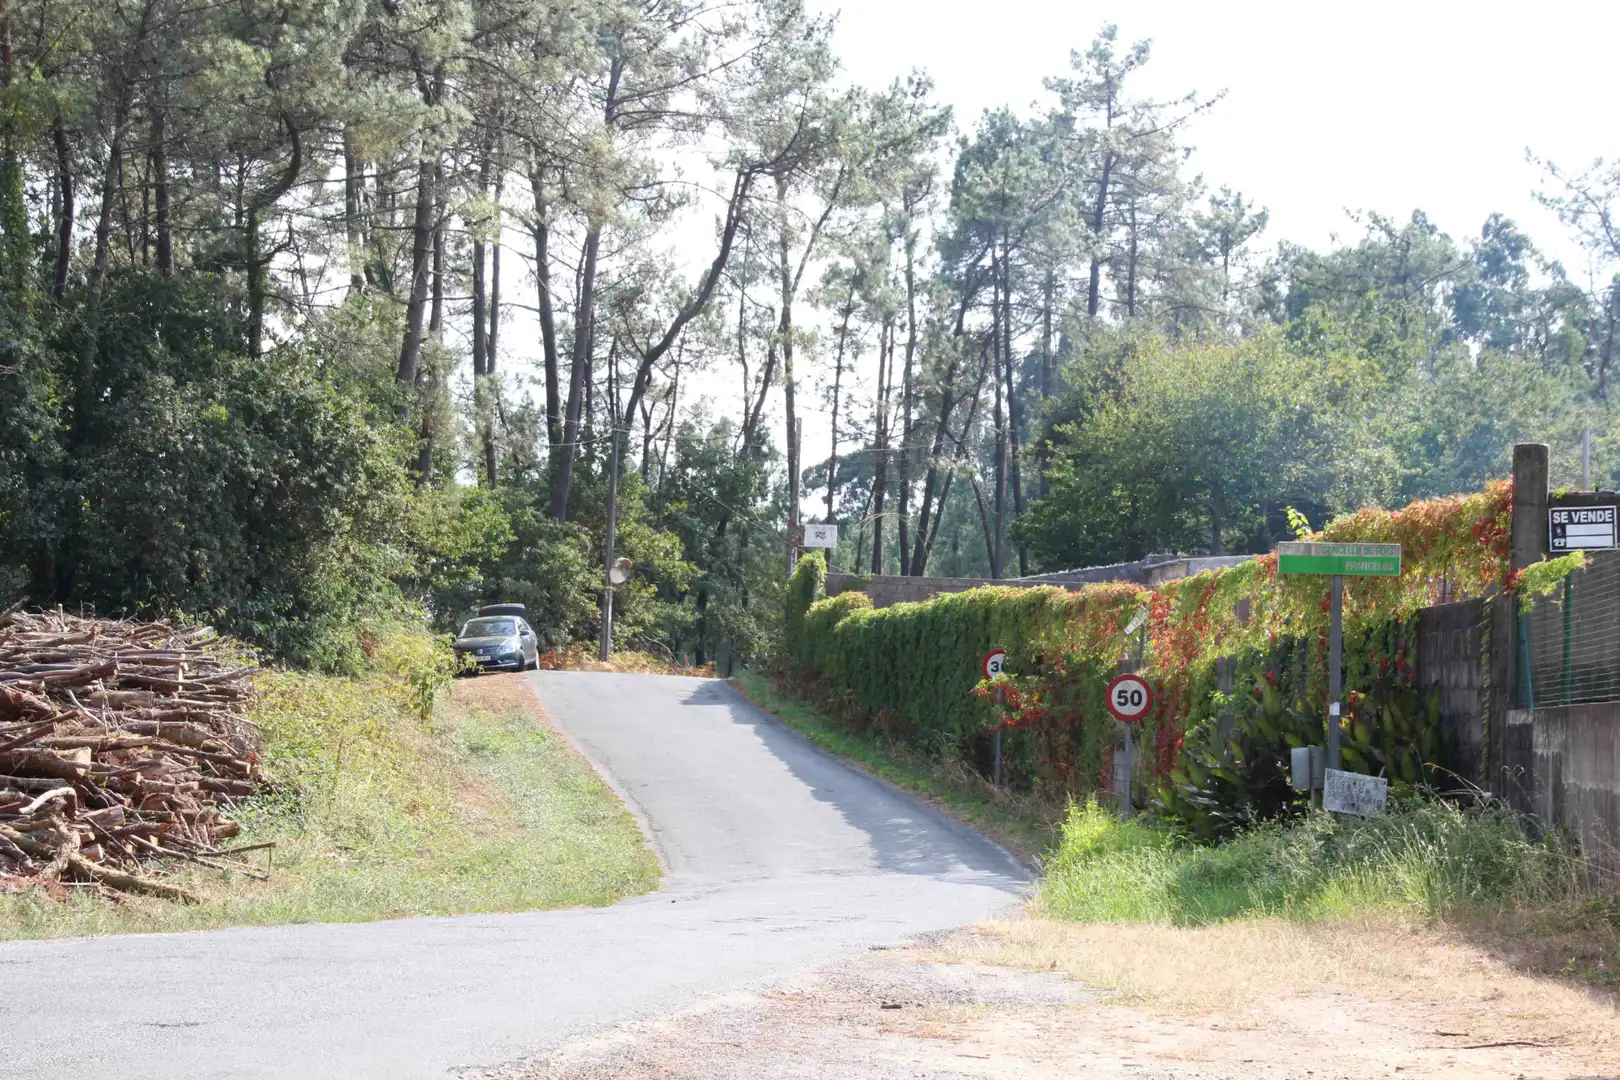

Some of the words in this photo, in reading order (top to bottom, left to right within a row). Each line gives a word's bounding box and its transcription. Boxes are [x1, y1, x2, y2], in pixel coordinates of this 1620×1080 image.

[1552, 511, 1569, 524] SE
[1571, 510, 1613, 523] VENDE
[1322, 546, 1361, 555] CONCELLO
[1117, 689, 1142, 706] 50
